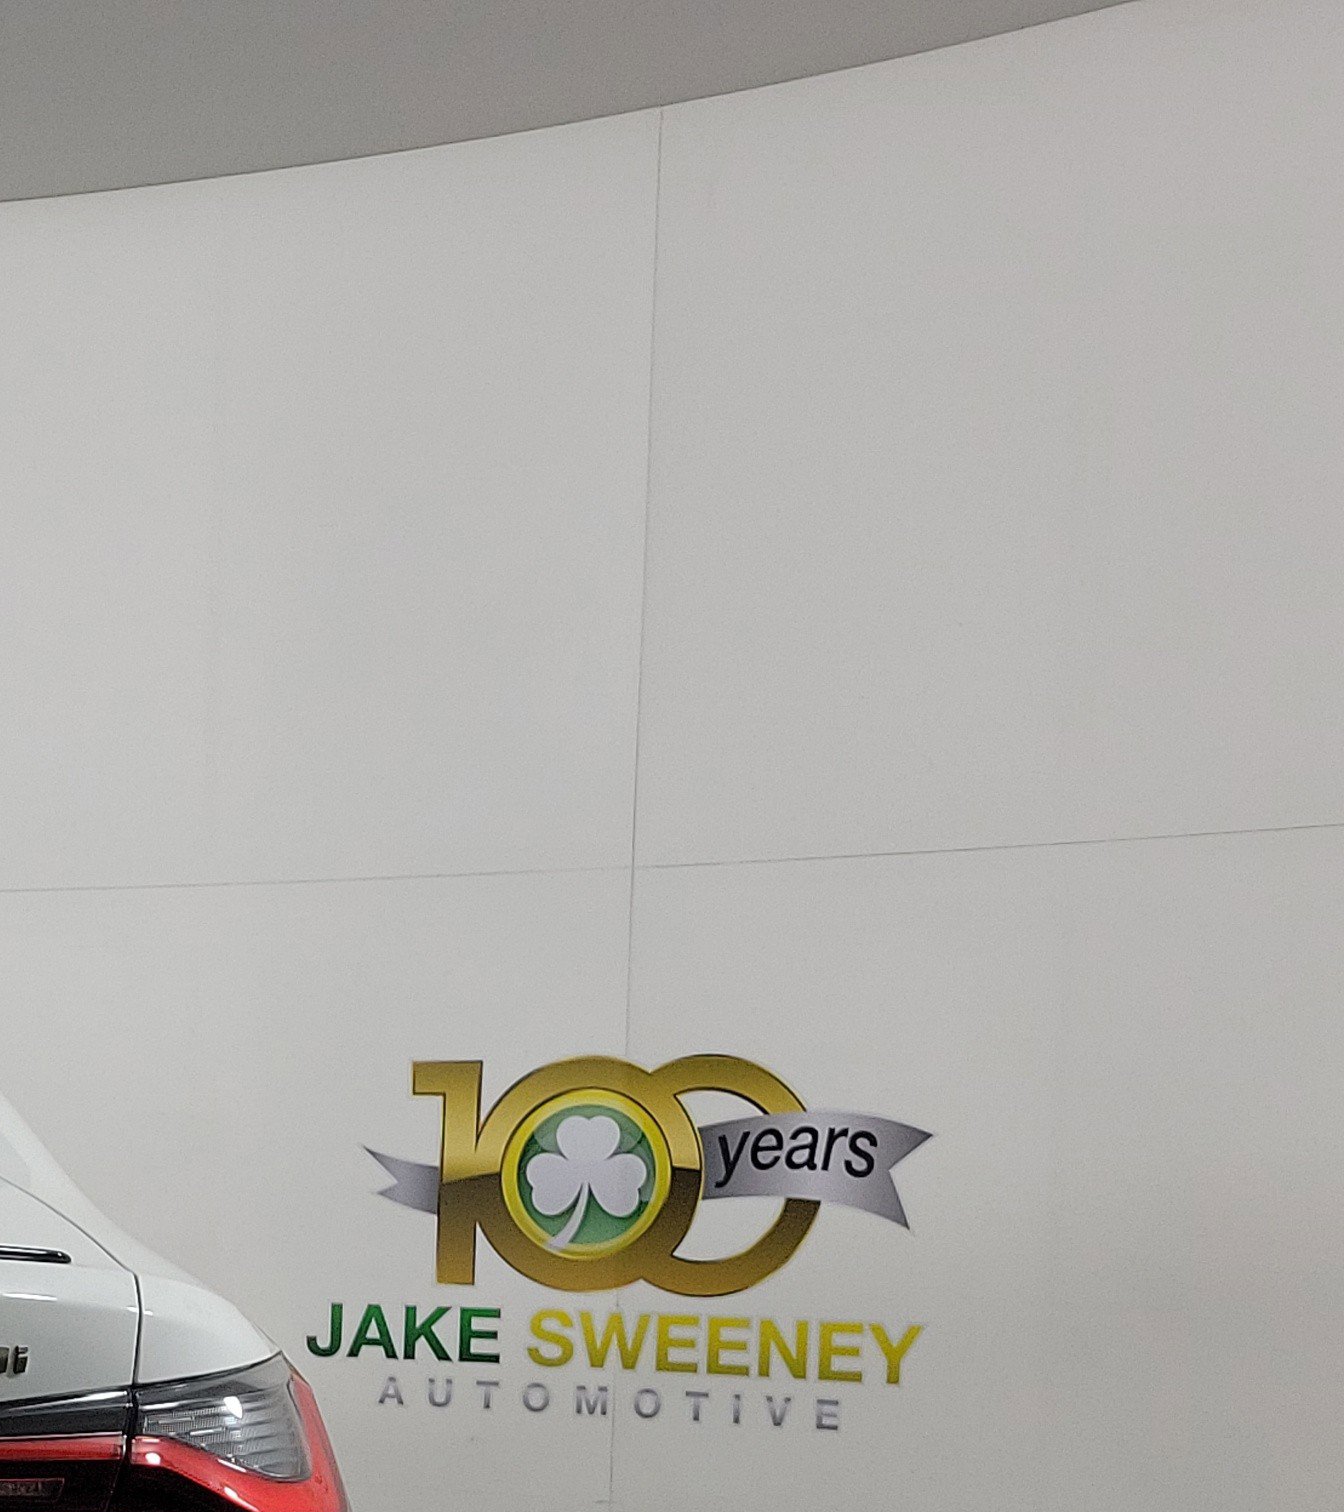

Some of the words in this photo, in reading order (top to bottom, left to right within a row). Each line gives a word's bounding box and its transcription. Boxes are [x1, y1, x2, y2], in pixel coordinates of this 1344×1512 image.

[412, 1053, 822, 1298] 100
[714, 1124, 879, 1188] years
[306, 1302, 502, 1364] JAKE
[526, 1309, 925, 1385] SWEENEY
[377, 1376, 842, 1431] AUTOMOTIVE
